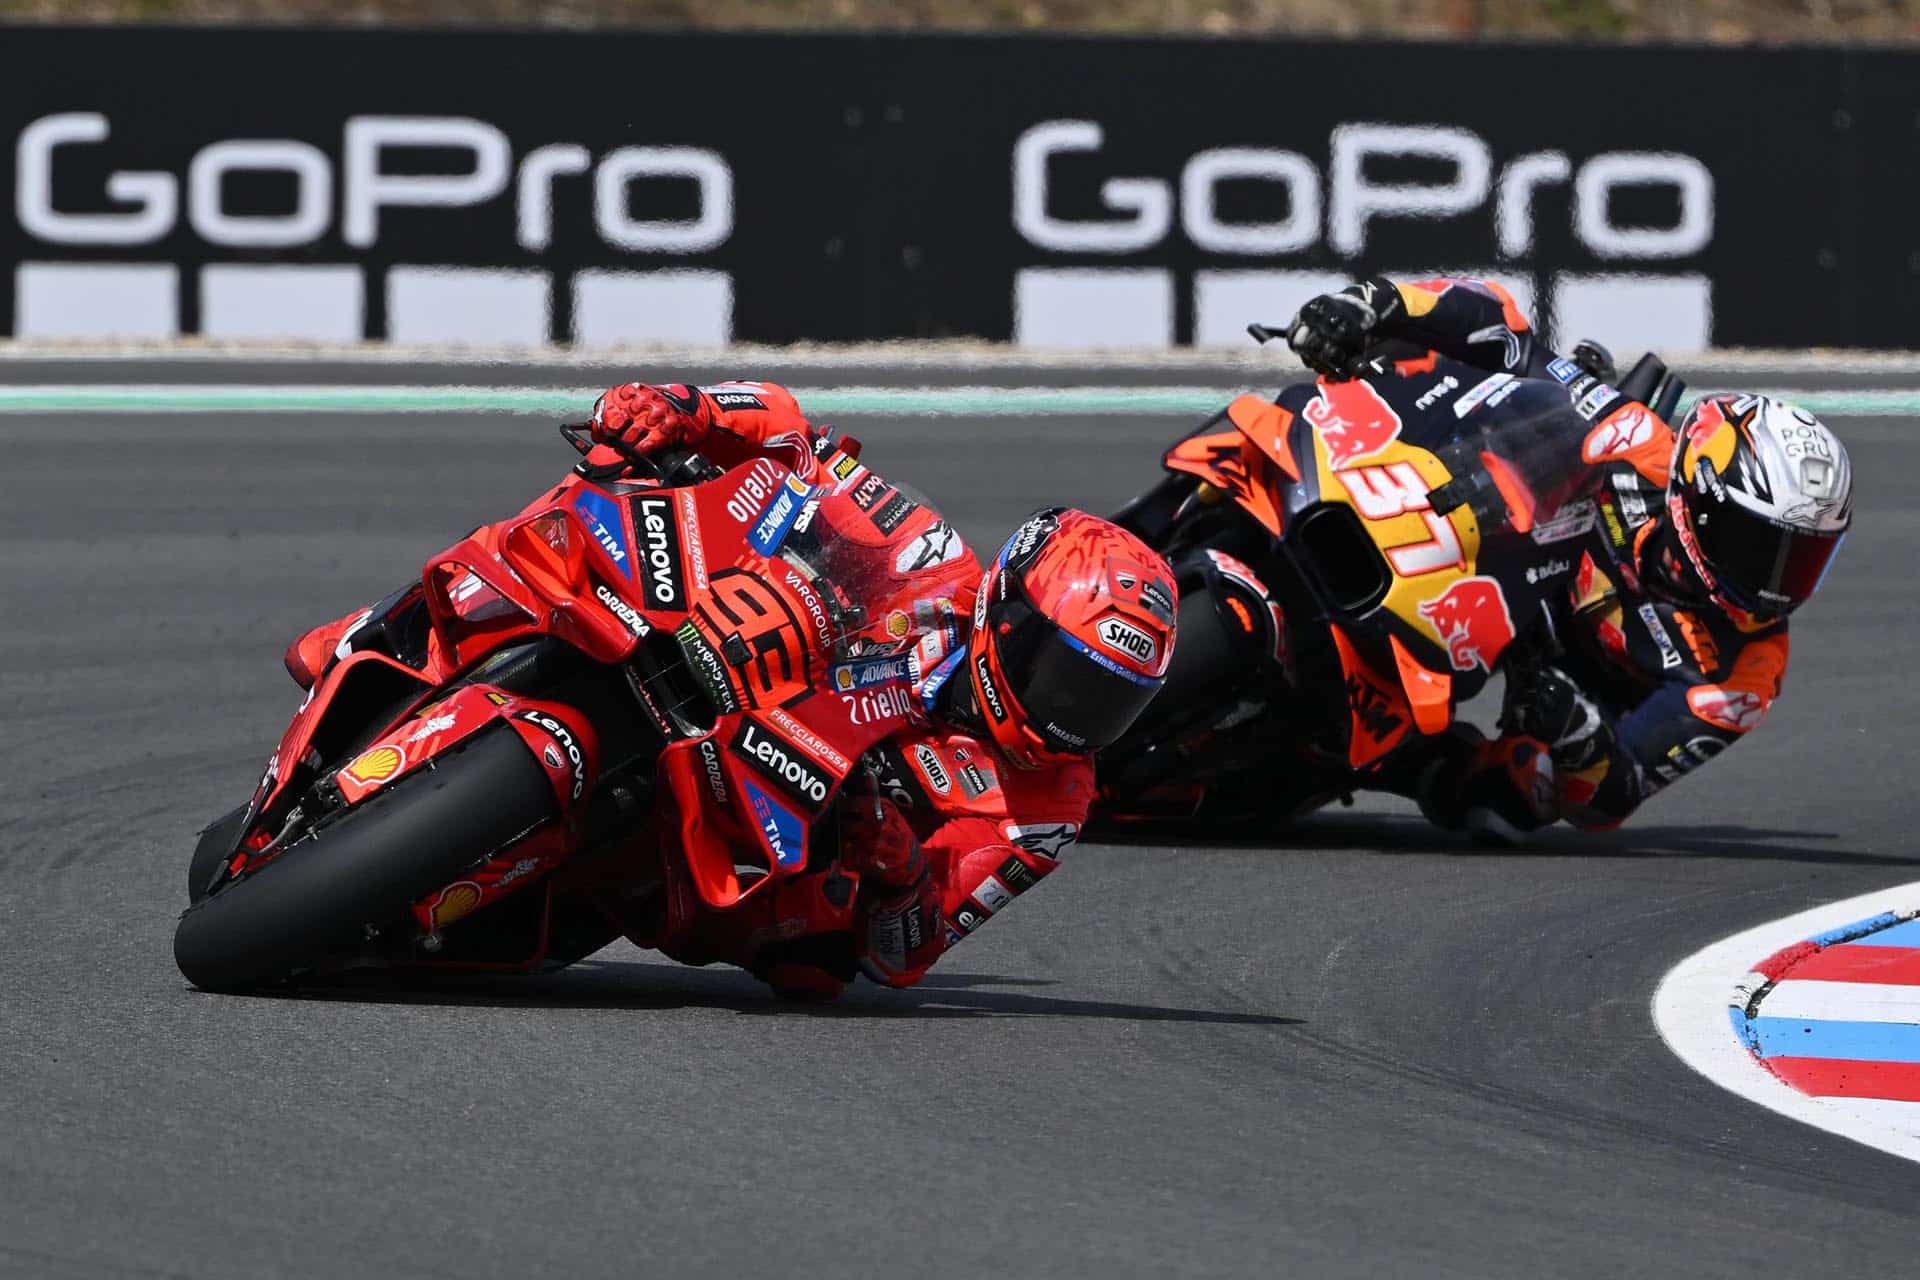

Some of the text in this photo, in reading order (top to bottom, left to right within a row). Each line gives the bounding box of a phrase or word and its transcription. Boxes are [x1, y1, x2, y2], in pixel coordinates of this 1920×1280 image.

[14, 112, 735, 253] GoPro
[1011, 119, 1715, 259] GoPro
[594, 523, 625, 562] TIM
[682, 491, 708, 591] FRECCIAROSSA
[756, 491, 793, 544] ADVANCE
[1334, 460, 1467, 578] 37
[641, 499, 675, 603] Lenovo
[597, 585, 650, 637] CARRERA
[784, 571, 831, 649] VARGROUP
[860, 657, 907, 684] ADVANCE
[1106, 623, 1152, 660] SHOEI
[693, 640, 734, 713] MONSTER
[922, 675, 943, 698] TIM
[977, 657, 1003, 717] Lenovo
[525, 711, 585, 799] Lenovo
[742, 726, 827, 802] Lenovo
[769, 709, 849, 770] FRECCIAROSSA
[919, 750, 948, 789] SHOEI
[765, 819, 786, 860] TIM
